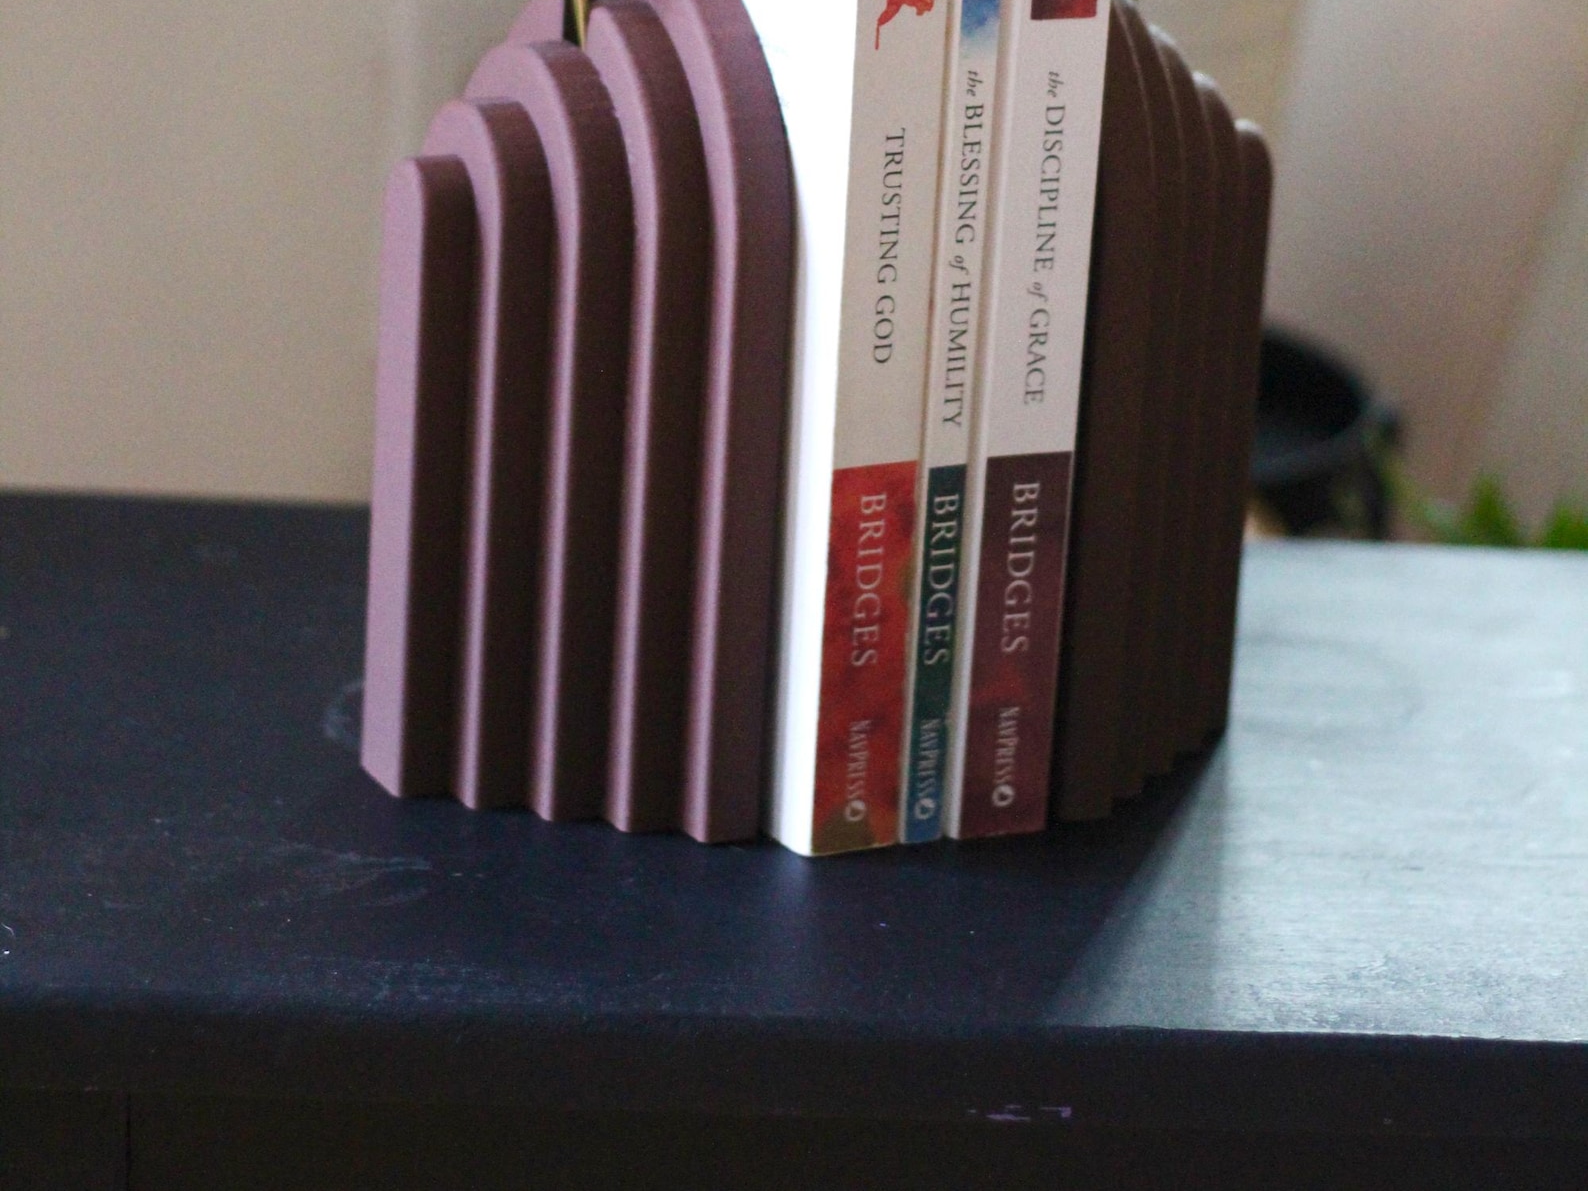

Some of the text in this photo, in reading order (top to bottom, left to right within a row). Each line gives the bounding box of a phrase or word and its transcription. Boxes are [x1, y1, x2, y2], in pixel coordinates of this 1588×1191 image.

[873, 126, 906, 365] TRUSTING GOD
[943, 69, 984, 427] the BLESSING of HUMILITY
[1023, 71, 1066, 405] the DISCIPLINE of GRACE
[851, 493, 887, 668] BRIDGES
[923, 493, 959, 666] BRIDGES
[1001, 482, 1041, 654] BRIDGES
